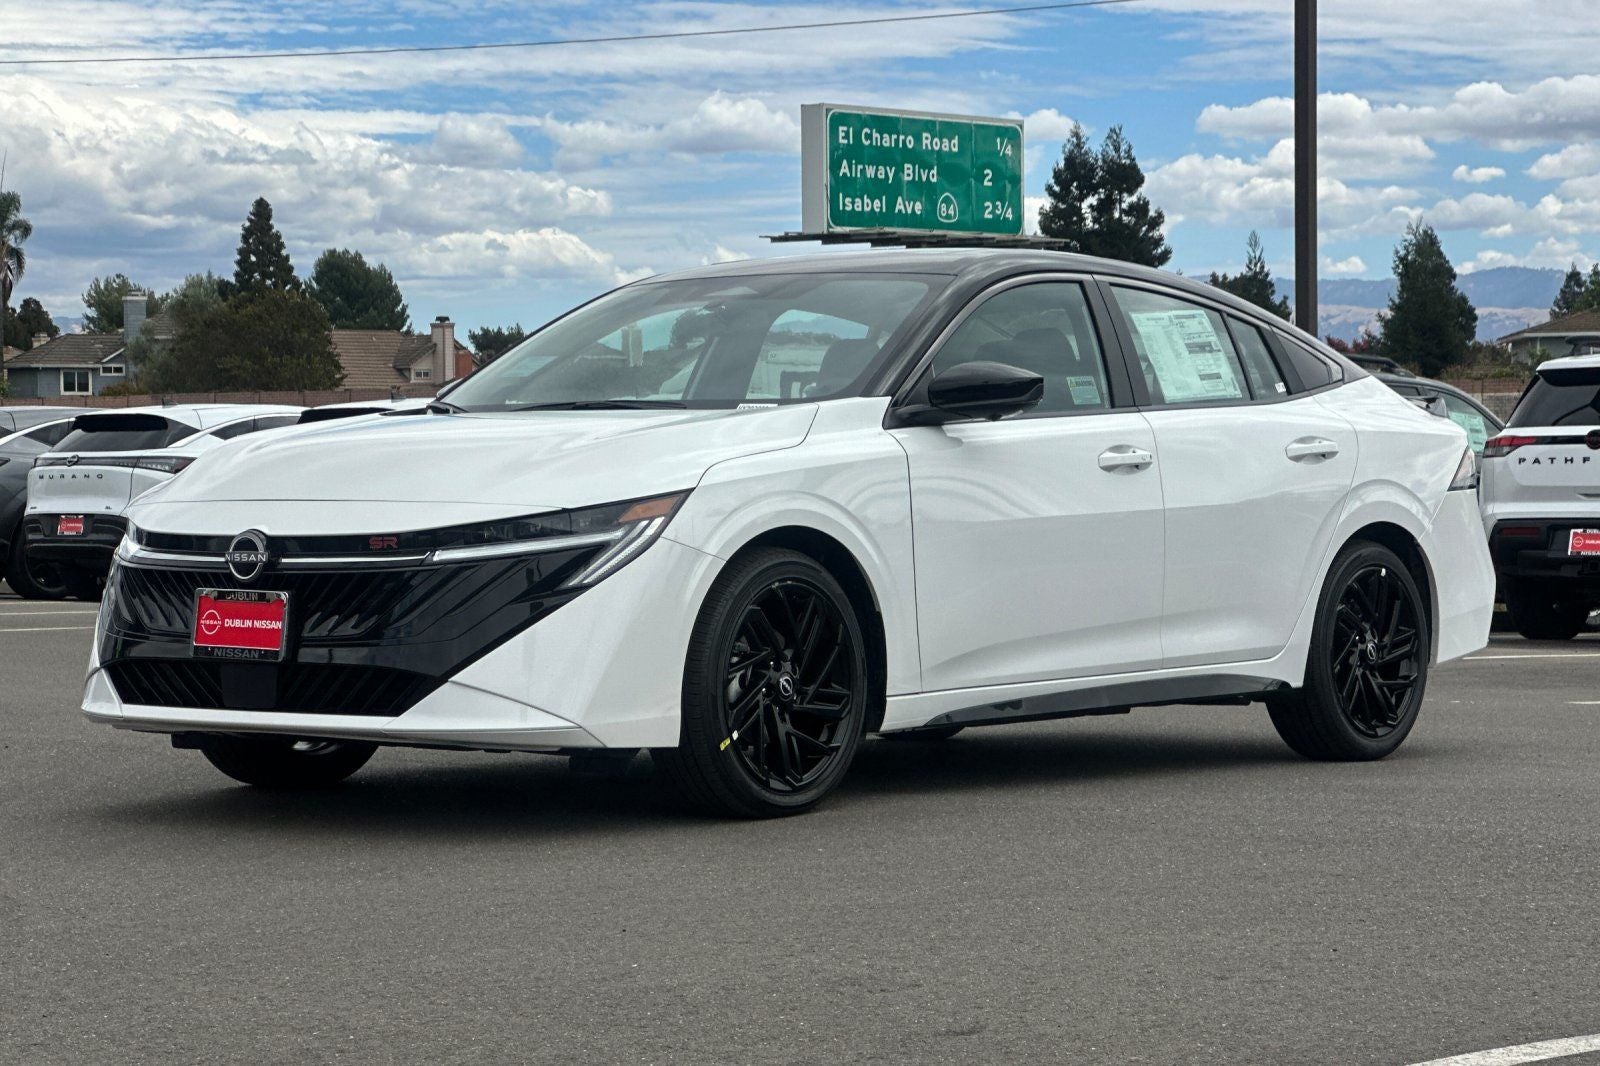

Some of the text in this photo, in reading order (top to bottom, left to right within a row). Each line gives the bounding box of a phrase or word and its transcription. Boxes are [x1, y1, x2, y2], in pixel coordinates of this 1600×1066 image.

[838, 126, 853, 145] El
[861, 128, 914, 149] Charro
[922, 132, 959, 152] Road
[839, 159, 993, 187] Airway Blvd 2
[839, 192, 886, 213] Isabel
[894, 196, 923, 215] Ave
[940, 204, 955, 218] 84
[1518, 456, 1591, 465] PATHF
[368, 535, 398, 549] SR
[225, 553, 267, 562] NISSAN
[225, 590, 259, 601] DUBLIN
[224, 618, 282, 630] DUBLIN NISSAN
[213, 647, 259, 659] NISSAN
